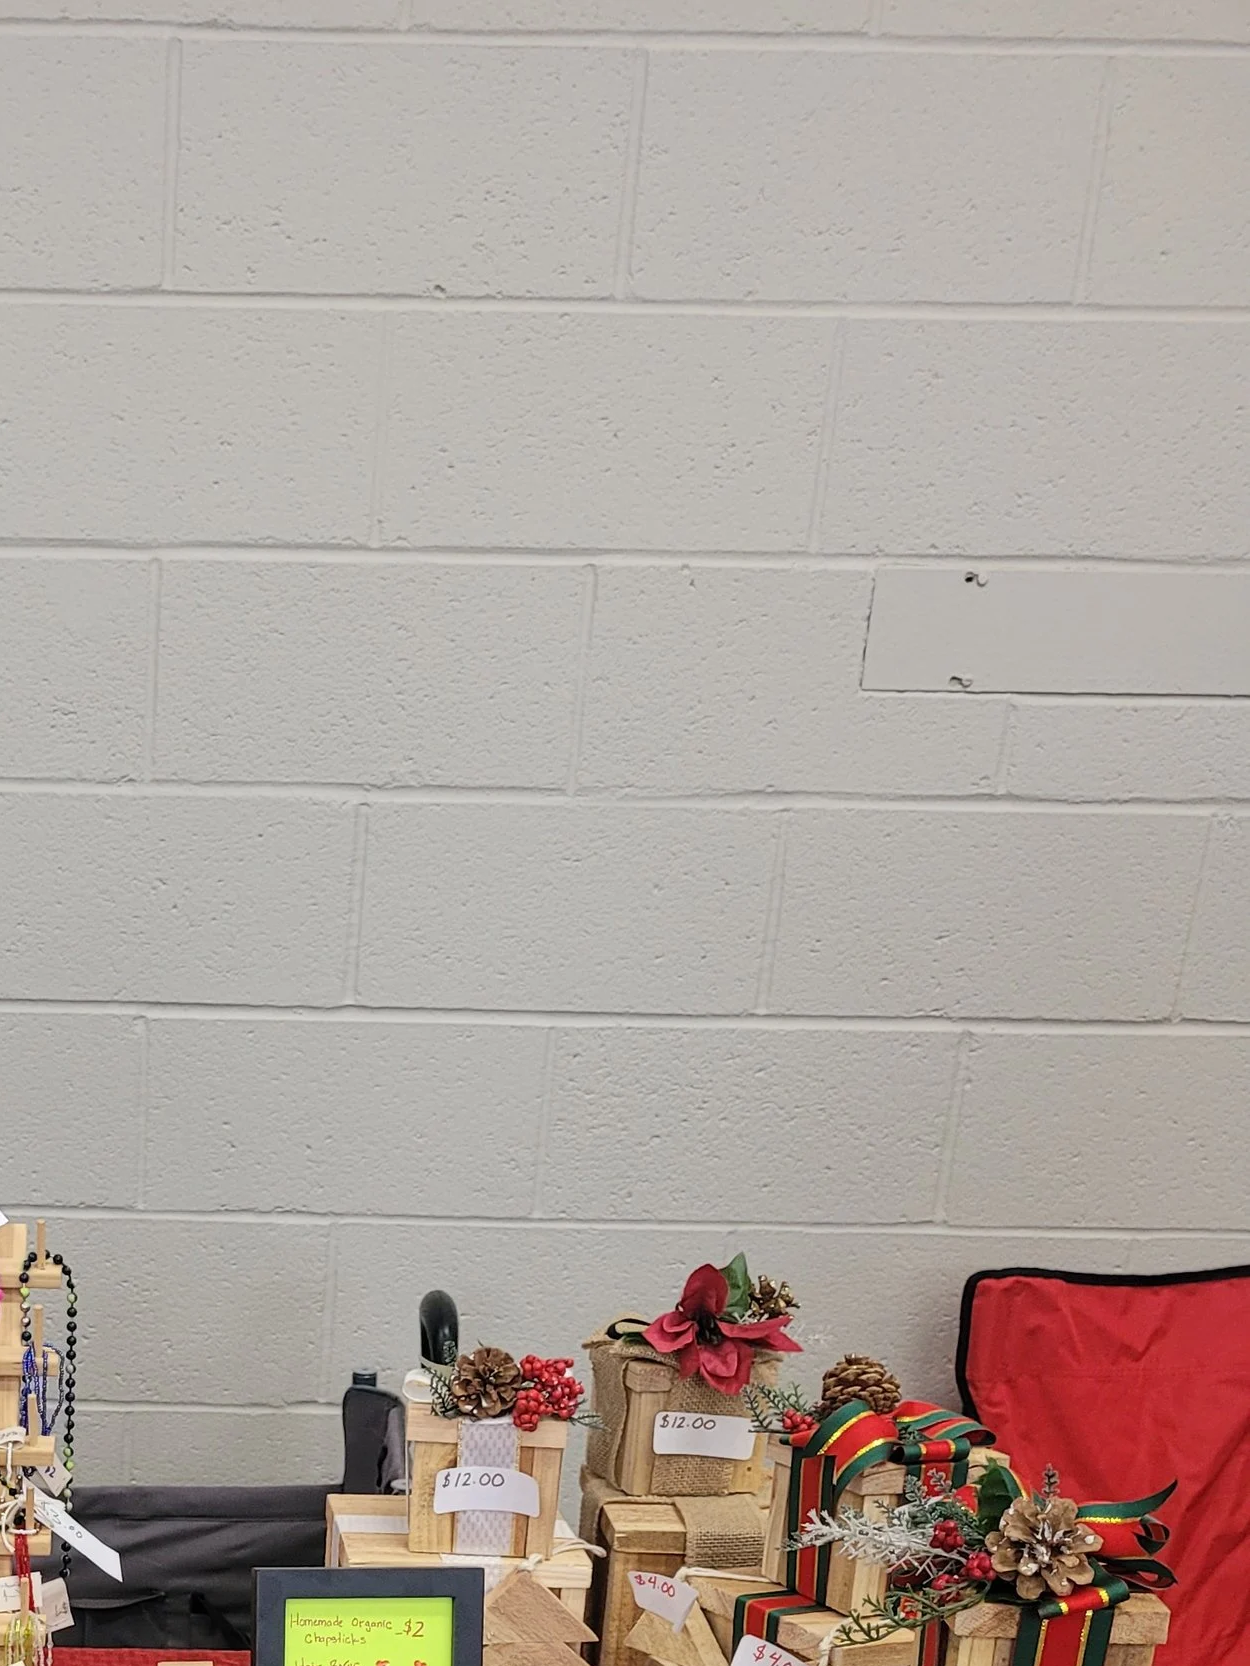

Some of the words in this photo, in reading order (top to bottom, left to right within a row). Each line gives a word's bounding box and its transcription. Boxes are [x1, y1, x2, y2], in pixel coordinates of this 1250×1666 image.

[659, 1414, 717, 1430] $12.00
[442, 1471, 505, 1489] $12.00
[634, 1574, 675, 1598] $4.00
[290, 1612, 343, 1628] Homemade
[351, 1617, 392, 1632] Organic
[304, 1632, 367, 1647] Chapsticks
